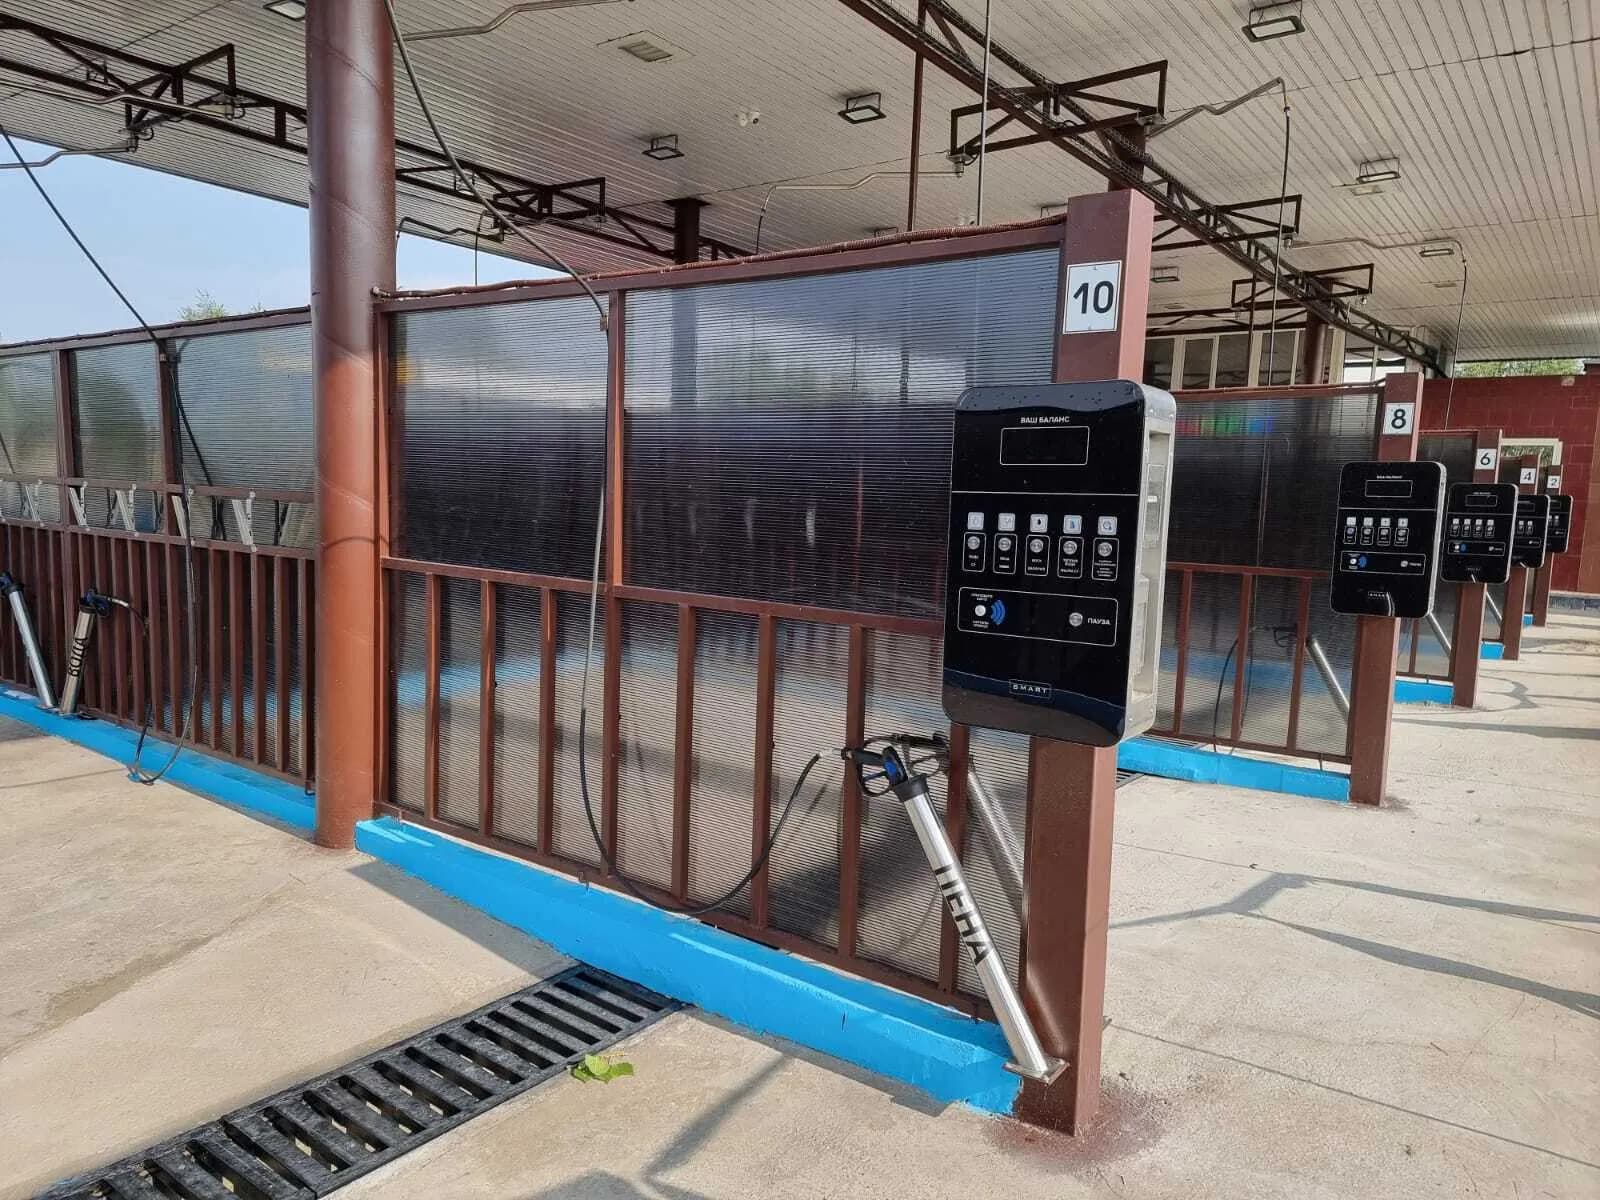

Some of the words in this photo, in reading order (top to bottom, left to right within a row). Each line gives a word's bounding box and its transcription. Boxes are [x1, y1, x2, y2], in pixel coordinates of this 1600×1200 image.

[1073, 281, 1114, 314] 10
[1020, 416, 1037, 424] ВАШ
[1391, 408, 1406, 429] 8
[1480, 452, 1491, 466] 6
[1523, 471, 1532, 481] 4
[1550, 478, 1557, 487] 2
[1087, 617, 1111, 626] ПАУЗА
[1012, 684, 1047, 694] SMART
[934, 864, 987, 966] ПЕНА
